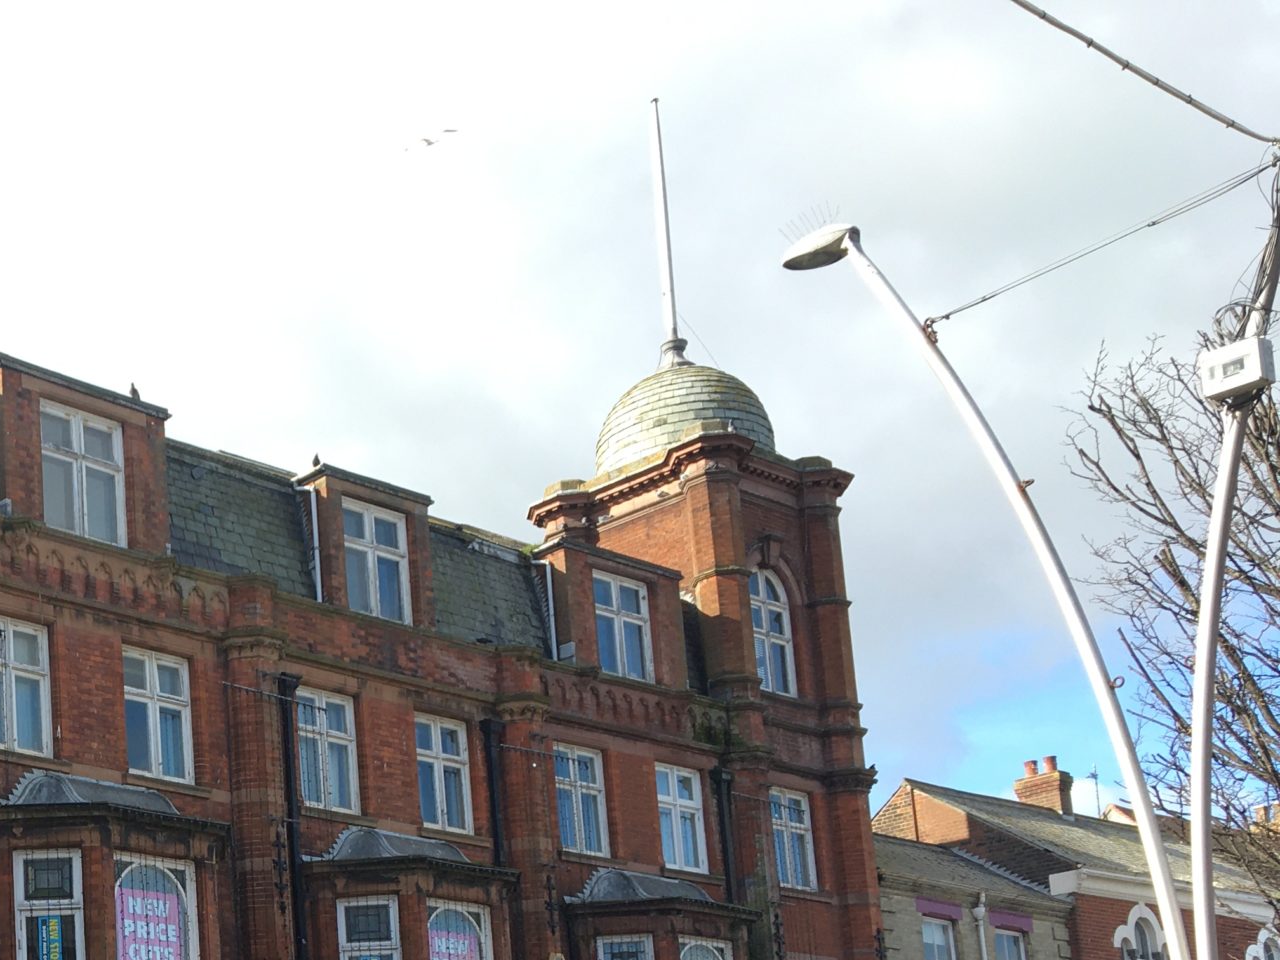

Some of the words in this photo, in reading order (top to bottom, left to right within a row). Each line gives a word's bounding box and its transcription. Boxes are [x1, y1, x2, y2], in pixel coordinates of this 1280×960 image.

[127, 896, 169, 917] NEW
[49, 919, 58, 939] NEW
[124, 919, 177, 942] PRICE
[435, 936, 468, 954] NEW
